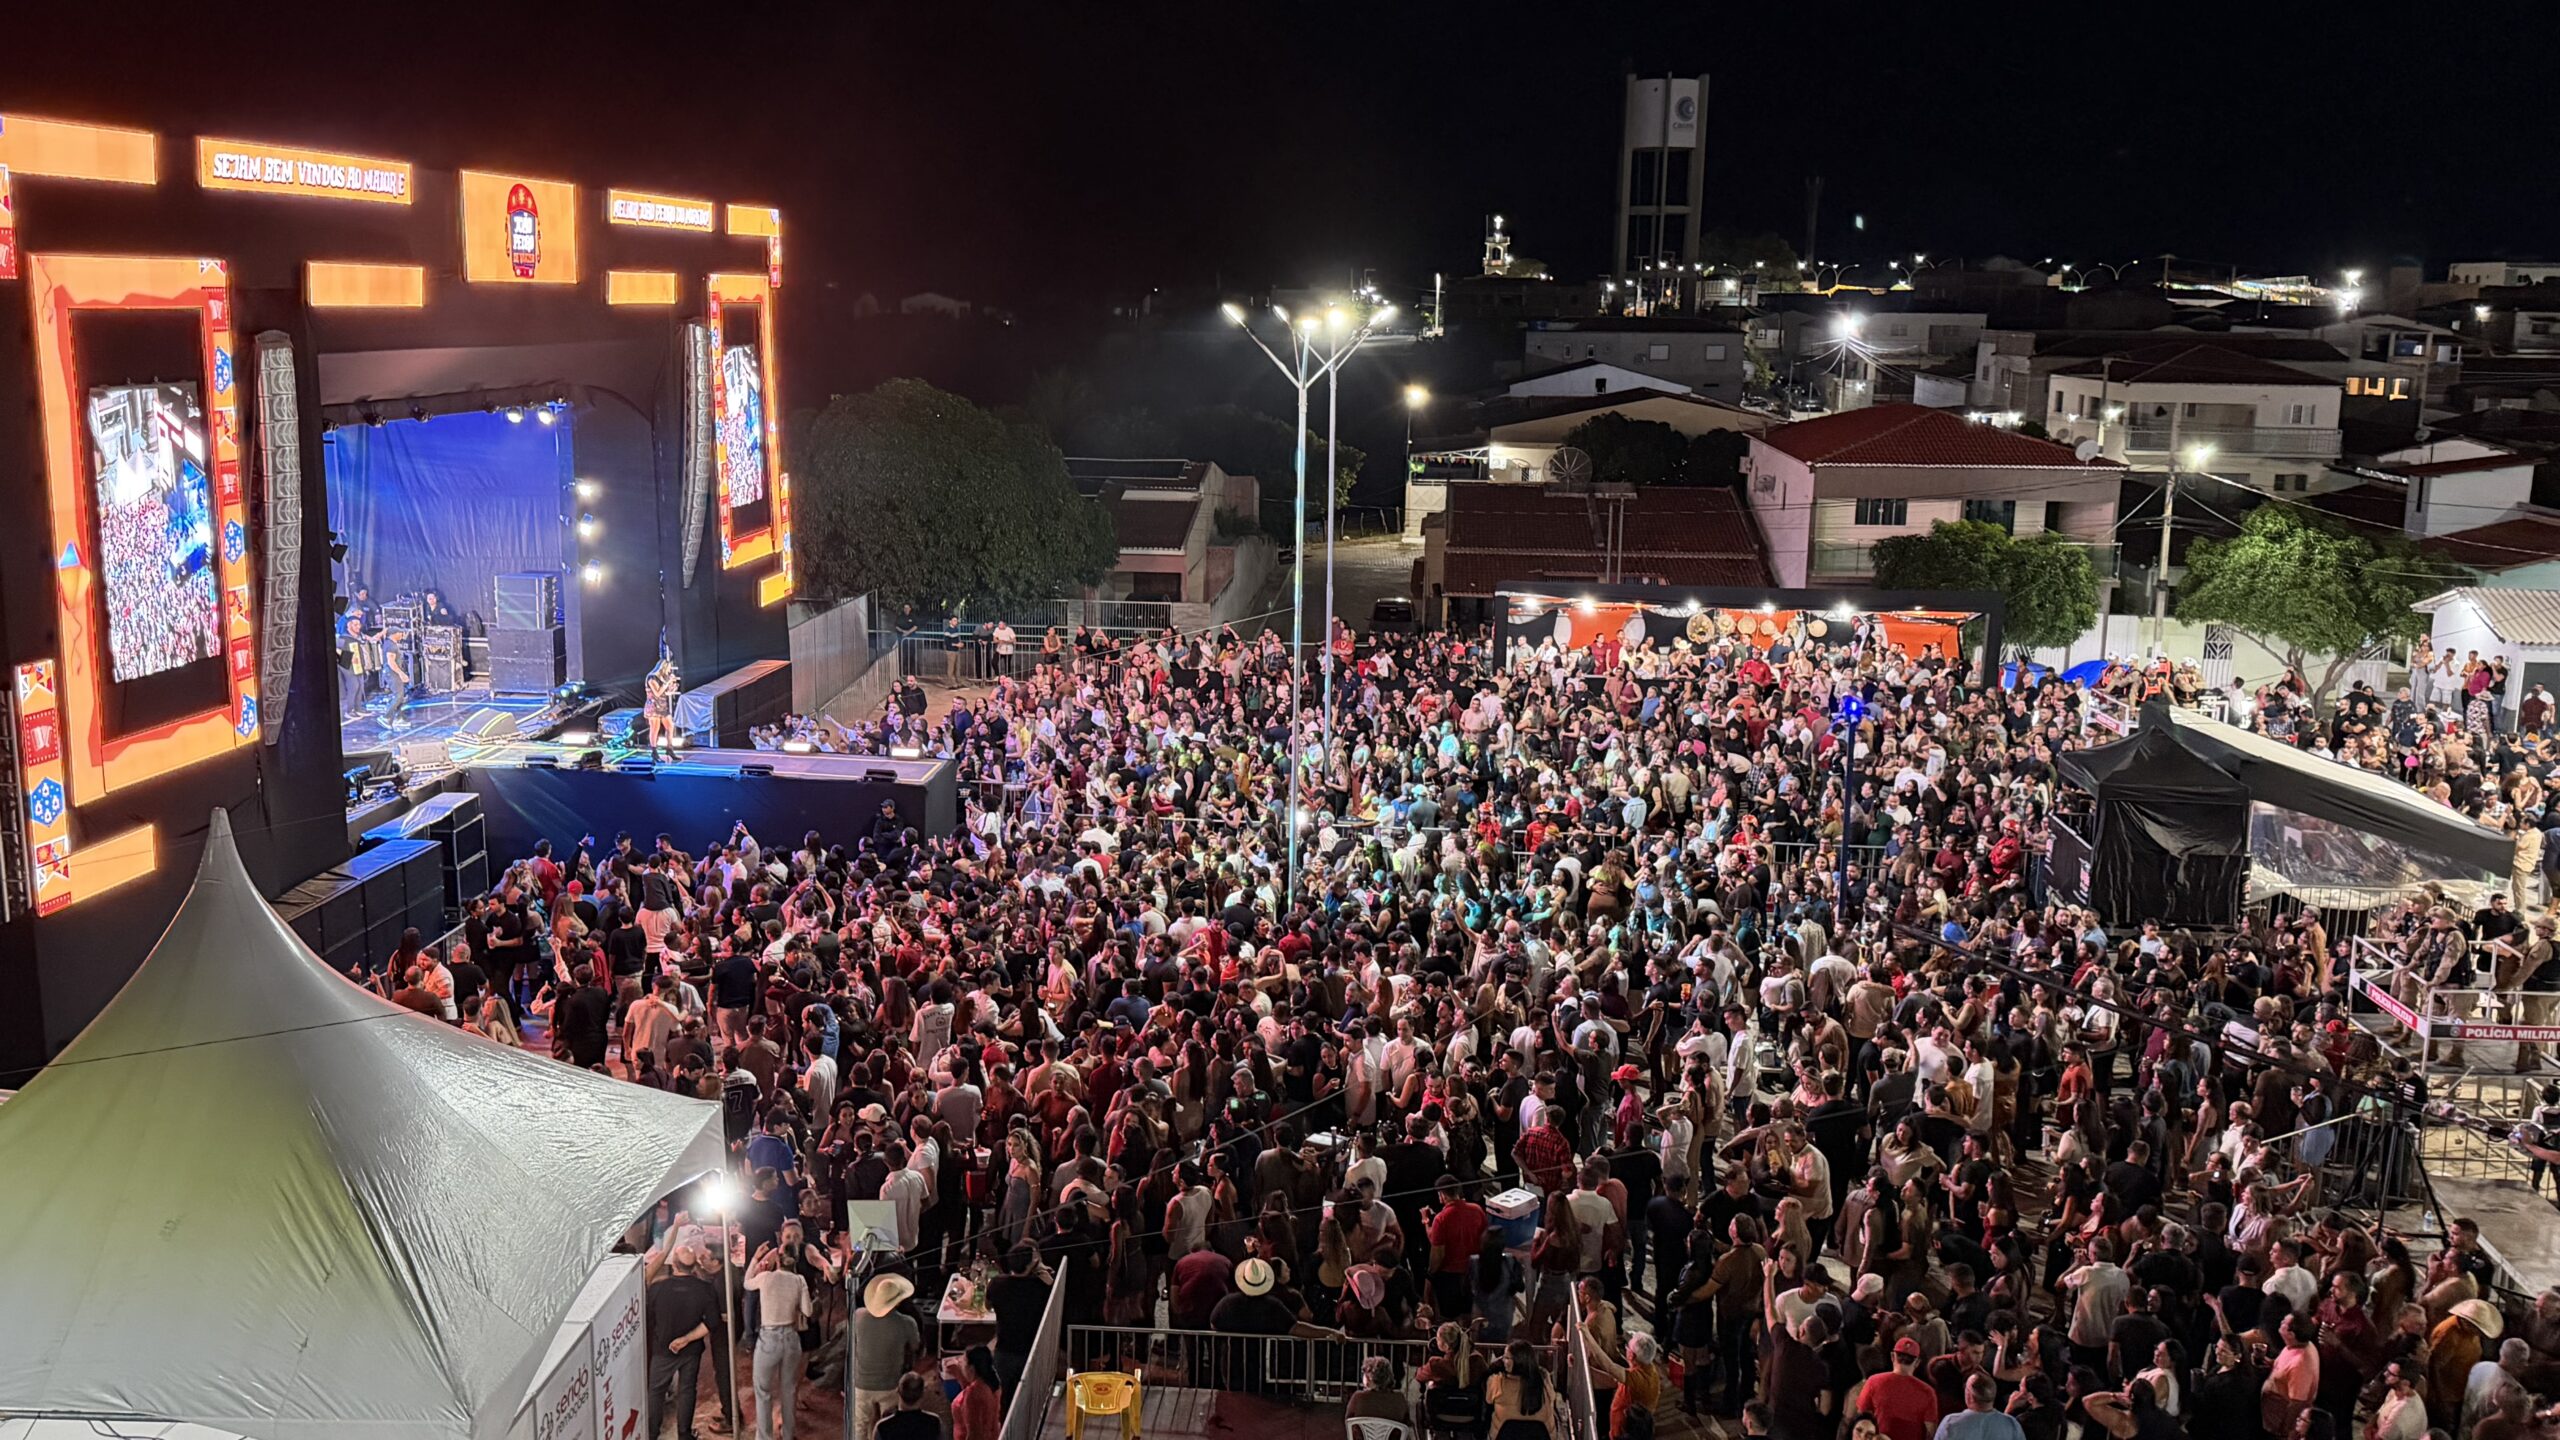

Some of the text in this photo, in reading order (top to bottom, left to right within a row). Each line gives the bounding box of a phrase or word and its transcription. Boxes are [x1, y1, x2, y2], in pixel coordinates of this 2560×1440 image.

[213, 152, 261, 182] SEJAM
[263, 156, 294, 184] BEM
[297, 160, 346, 188] VINDOS
[2466, 1027, 2514, 1038] POLÍCIA
[729, 1090, 743, 1112] 7
[611, 1293, 640, 1346] seridó
[612, 1317, 641, 1361] remoções
[555, 1364, 589, 1421] seridó
[556, 1388, 589, 1438] remoções
